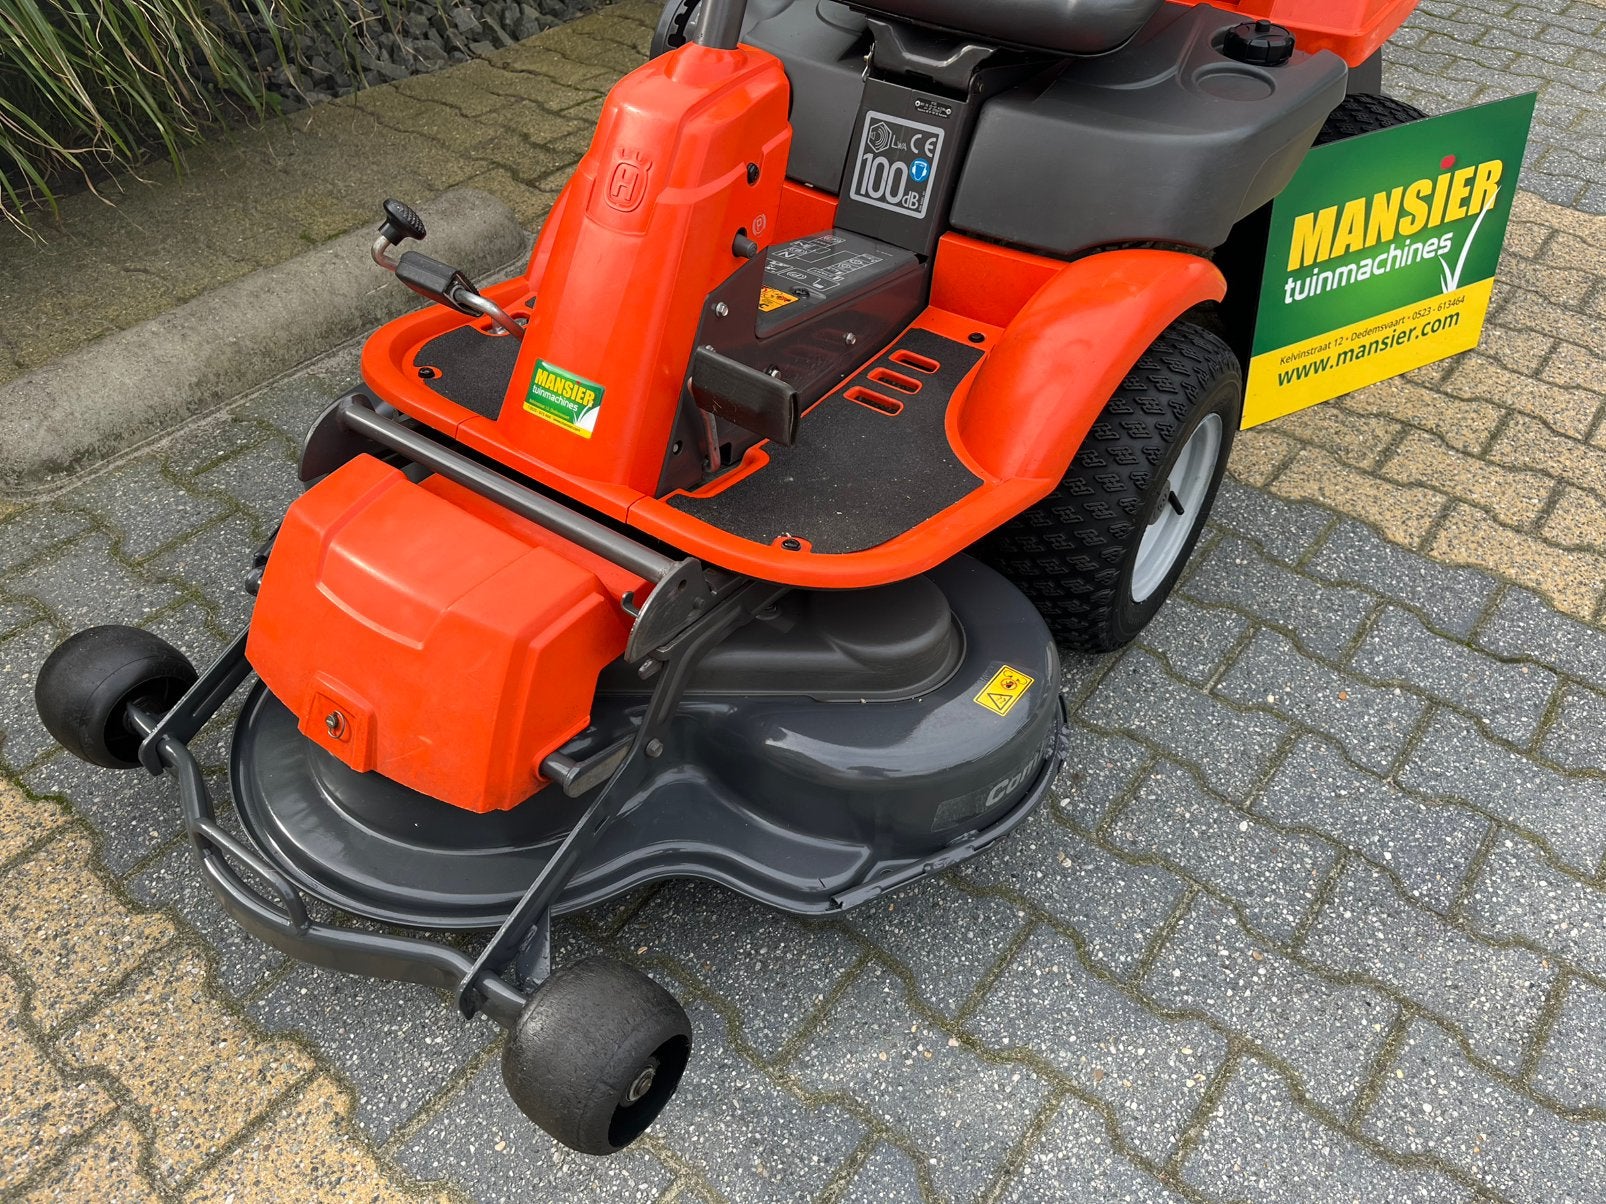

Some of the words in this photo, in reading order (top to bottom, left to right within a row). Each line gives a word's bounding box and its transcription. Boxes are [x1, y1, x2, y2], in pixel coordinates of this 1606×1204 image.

[910, 133, 937, 158] CE
[862, 152, 909, 204] 100
[901, 190, 919, 209] dB
[1286, 158, 1504, 272] MANSIER
[1284, 231, 1454, 305] tuinmachines
[1277, 310, 1461, 387] www.mansier.com
[1279, 341, 1332, 366] Kelvinstraat
[1333, 336, 1344, 348] 12
[1350, 315, 1406, 342] Dedemsvaart
[1411, 308, 1432, 321] 0523
[1437, 295, 1466, 312] 613464
[532, 384, 579, 412] tuinmachines
[534, 368, 595, 407] MANSIER
